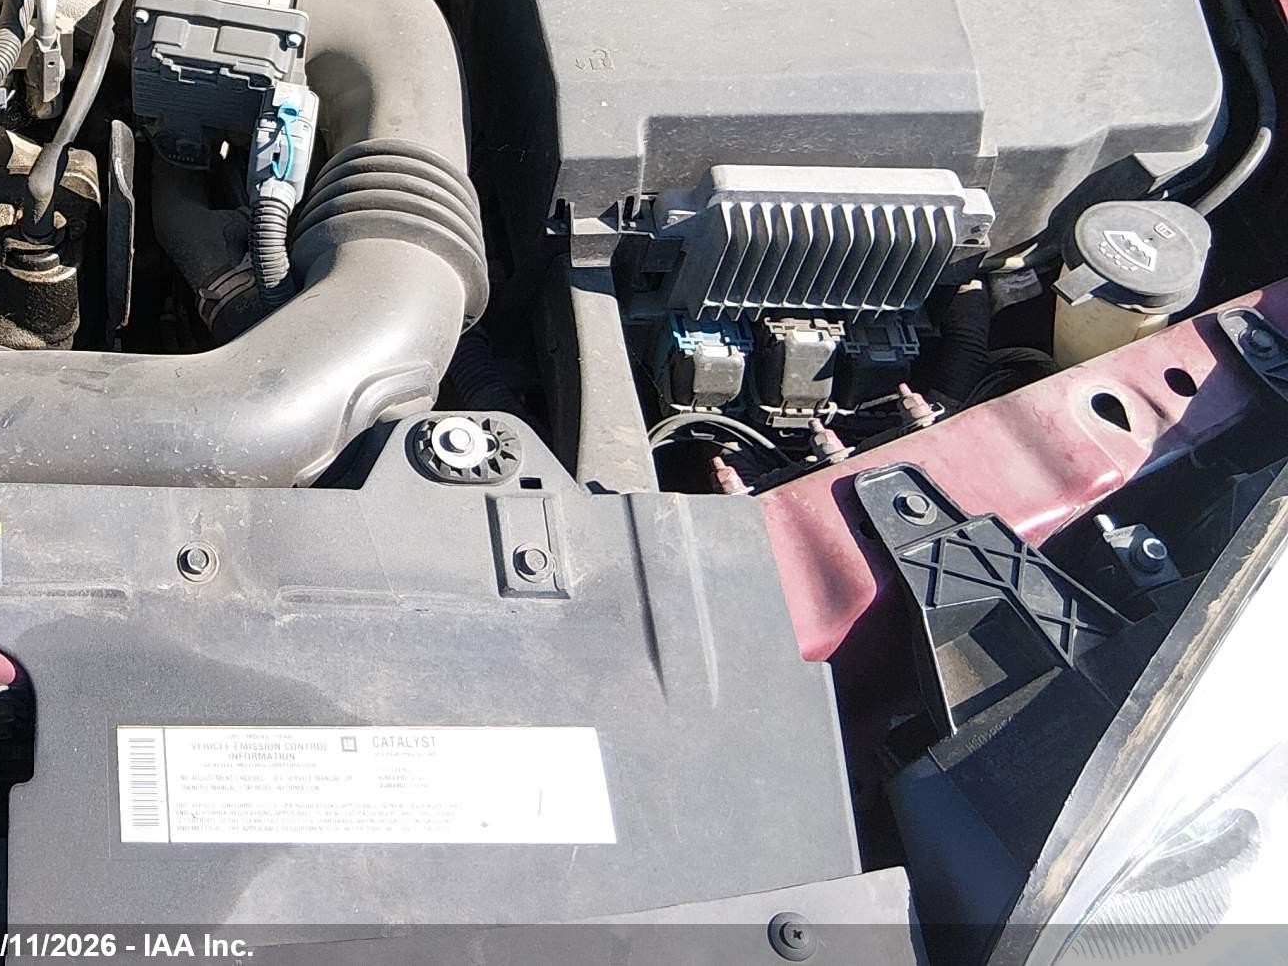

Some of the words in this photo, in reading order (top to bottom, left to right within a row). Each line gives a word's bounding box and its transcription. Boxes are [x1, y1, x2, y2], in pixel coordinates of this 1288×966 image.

[233, 742, 281, 751] EMISSION
[284, 742, 328, 751] CONTROL
[371, 736, 436, 748] CATALYST
[228, 752, 296, 761] INFORMATION
